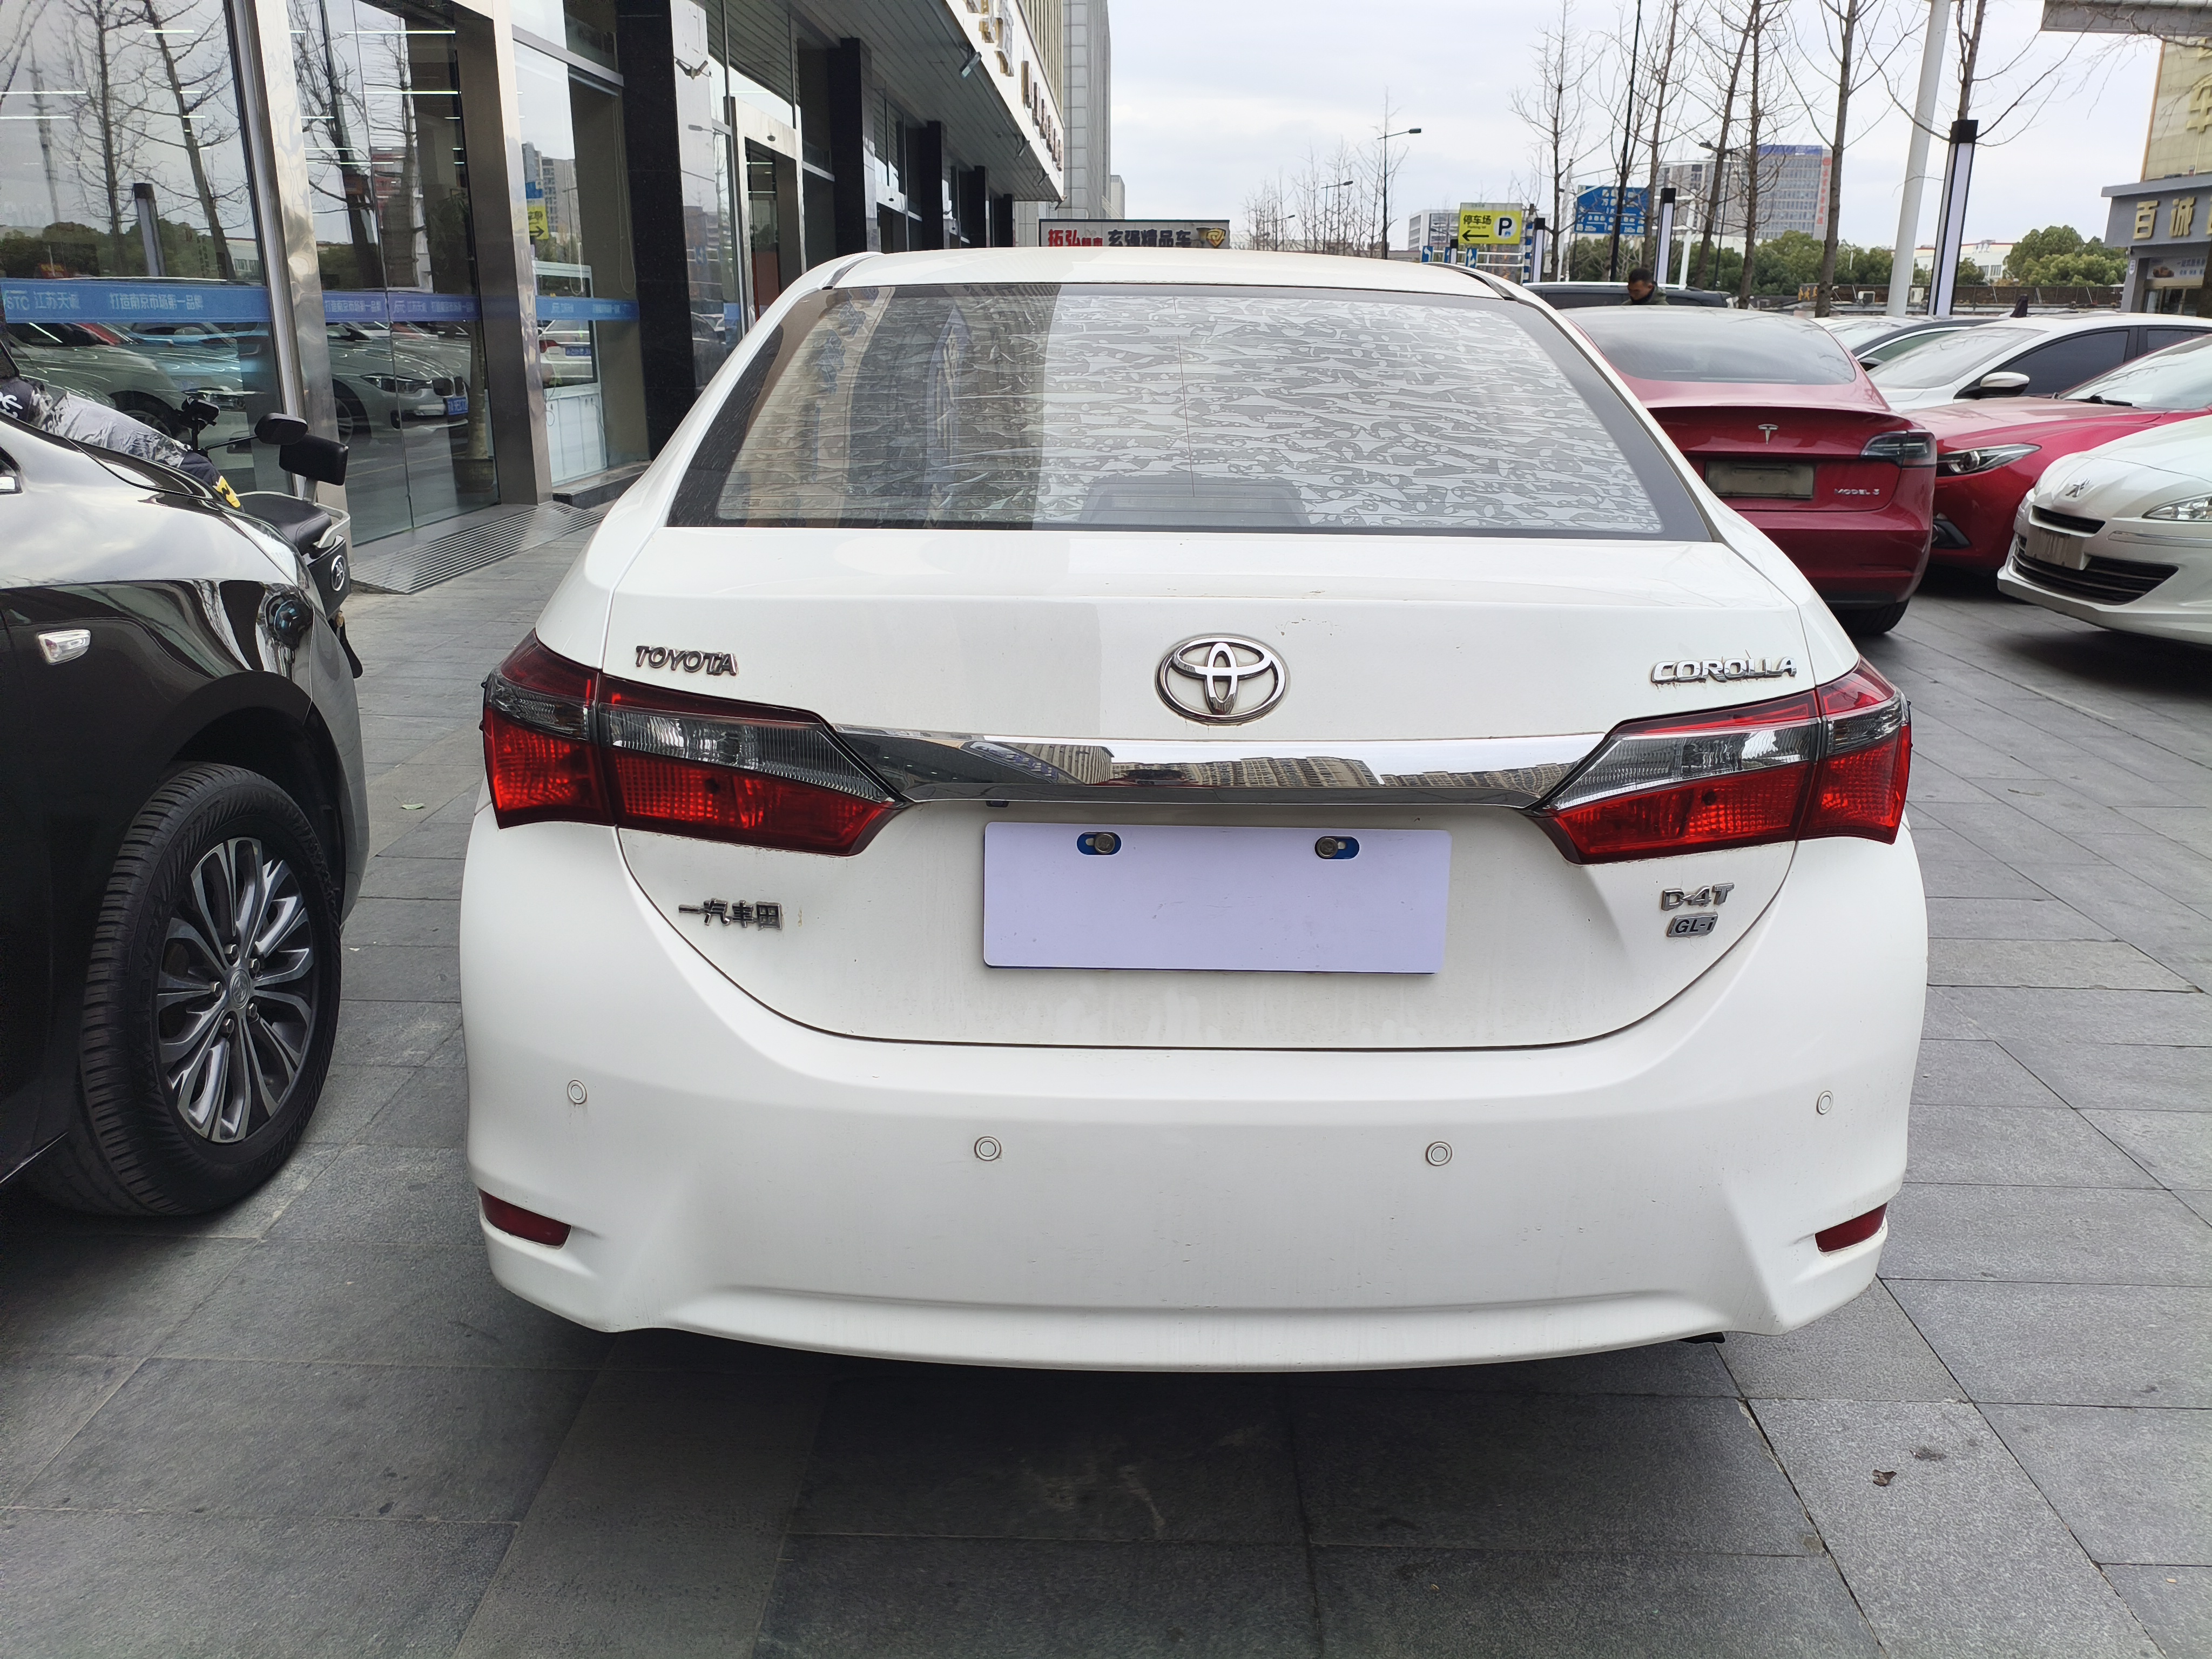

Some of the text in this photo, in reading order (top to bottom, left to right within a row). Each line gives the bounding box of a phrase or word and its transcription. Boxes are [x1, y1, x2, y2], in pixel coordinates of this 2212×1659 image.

[1464, 215, 1492, 225] 停车场
[1499, 218, 1512, 235] P
[2133, 196, 2212, 240] 百诚
[636, 645, 738, 676] TOYOTA
[1650, 656, 1798, 683] COROLLA
[1661, 882, 1735, 911] D-4T
[678, 898, 783, 929] 一汽丰田
[1675, 918, 1715, 934] GL-i
